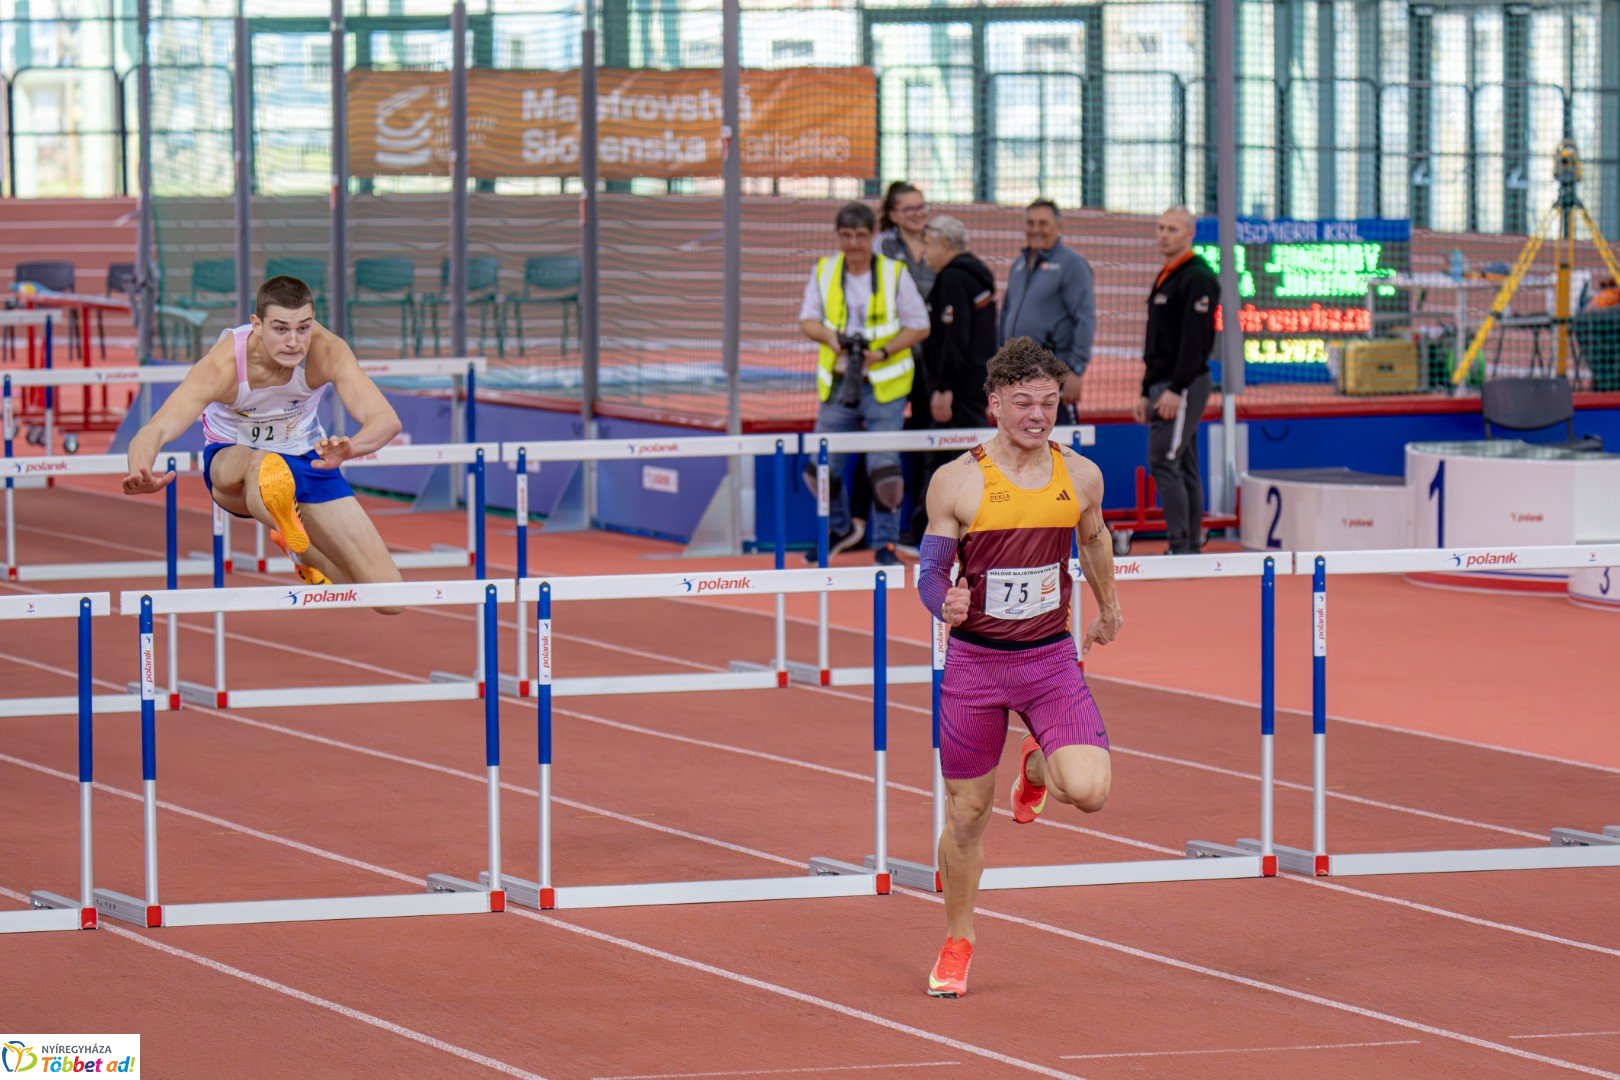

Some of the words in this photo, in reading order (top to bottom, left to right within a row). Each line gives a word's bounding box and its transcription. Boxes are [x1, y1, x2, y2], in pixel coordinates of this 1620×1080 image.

[522, 128, 706, 163] Sloenska
[252, 426, 274, 443] 92
[939, 433, 979, 446] polanik
[639, 441, 679, 454] polanik
[26, 461, 68, 474] polanik
[1429, 459, 1445, 549] 1
[1266, 485, 1282, 549] 2
[1114, 562, 1141, 574] anik
[1466, 552, 1518, 568] polanik
[697, 577, 751, 593] polanik
[1004, 582, 1029, 604] 75
[303, 589, 358, 606] polanik
[1317, 608, 1325, 640] polanik
[541, 635, 550, 668] polanik
[144, 650, 153, 683] polanik
